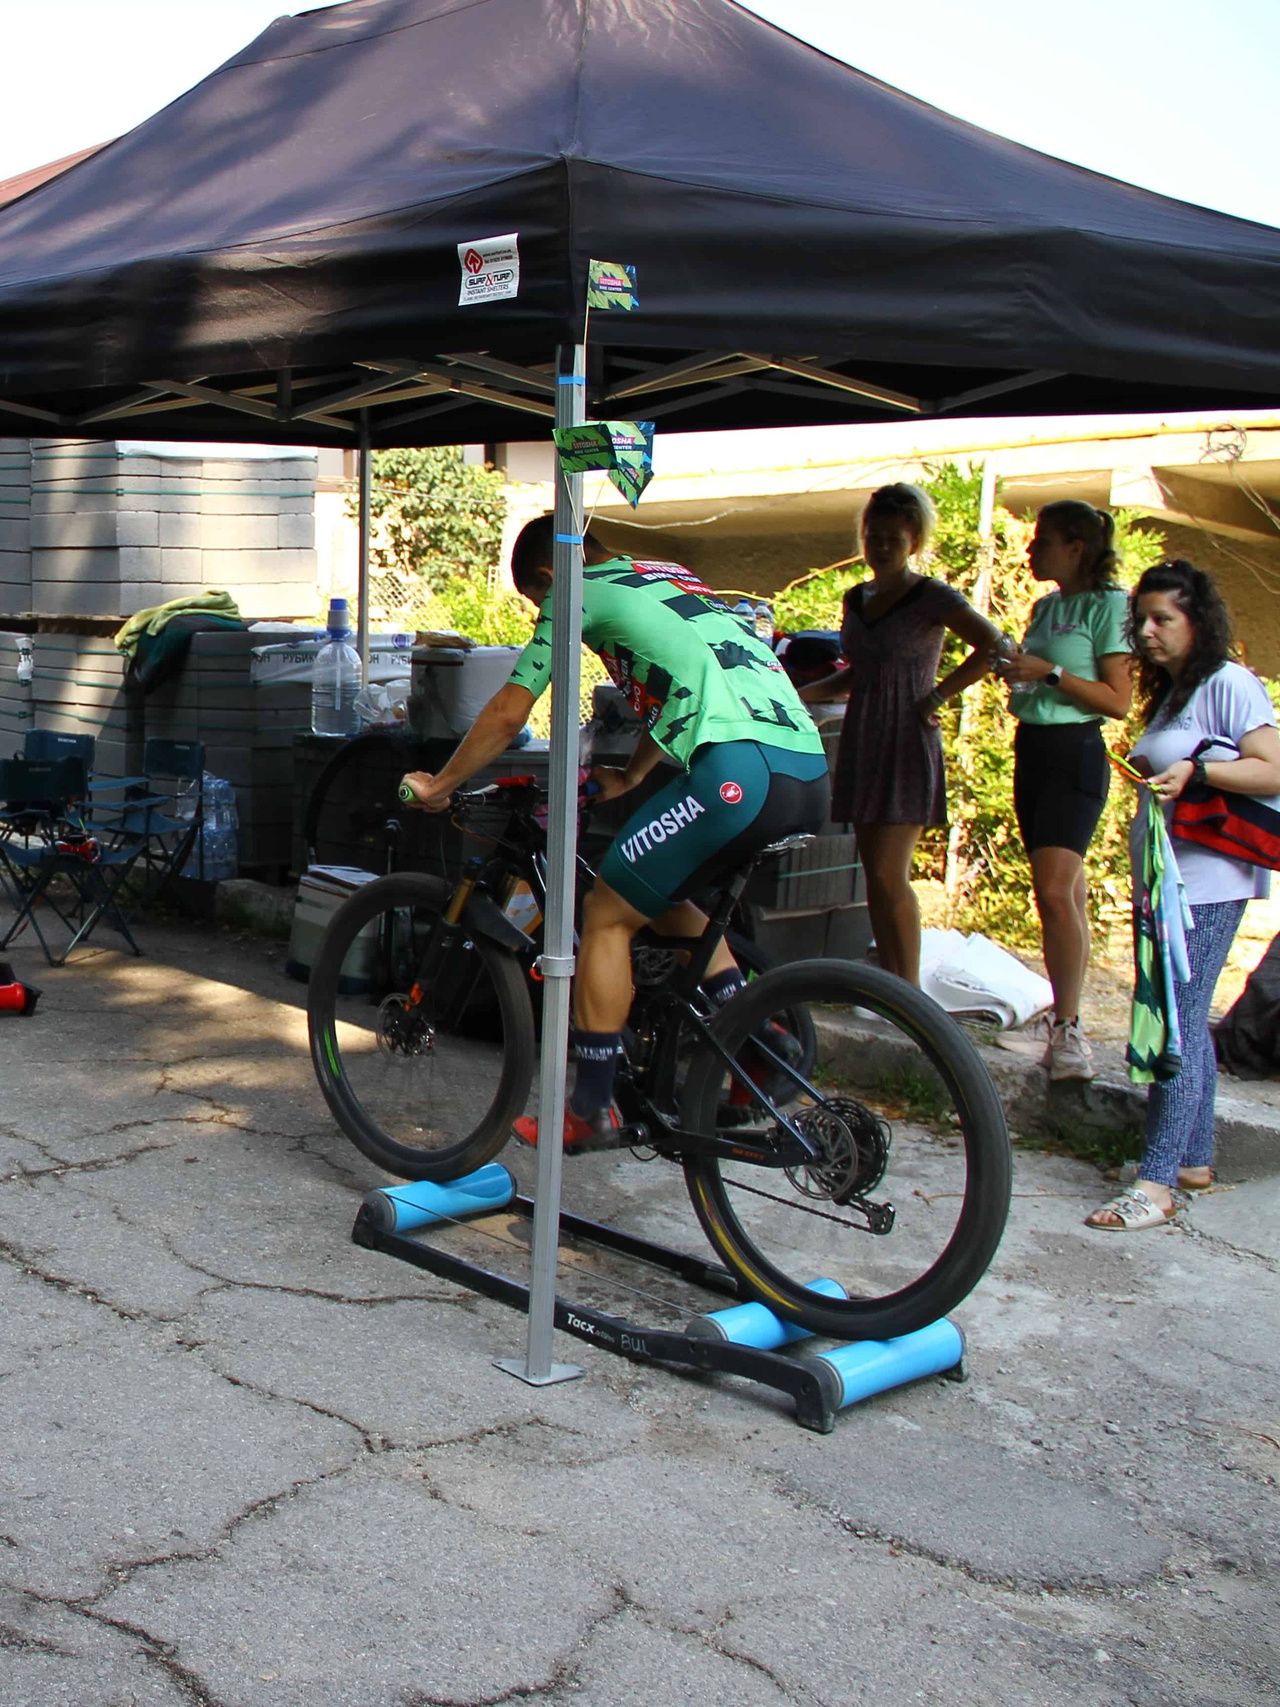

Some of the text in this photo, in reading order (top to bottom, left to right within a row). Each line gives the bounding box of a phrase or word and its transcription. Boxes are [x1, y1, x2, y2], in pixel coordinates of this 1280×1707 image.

[468, 272, 510, 286] SURF & TURF
[467, 288, 487, 296] INSTANT
[282, 653, 315, 664] РУБИК
[621, 795, 706, 863] VITOSHA
[567, 1313, 595, 1334] Tacx
